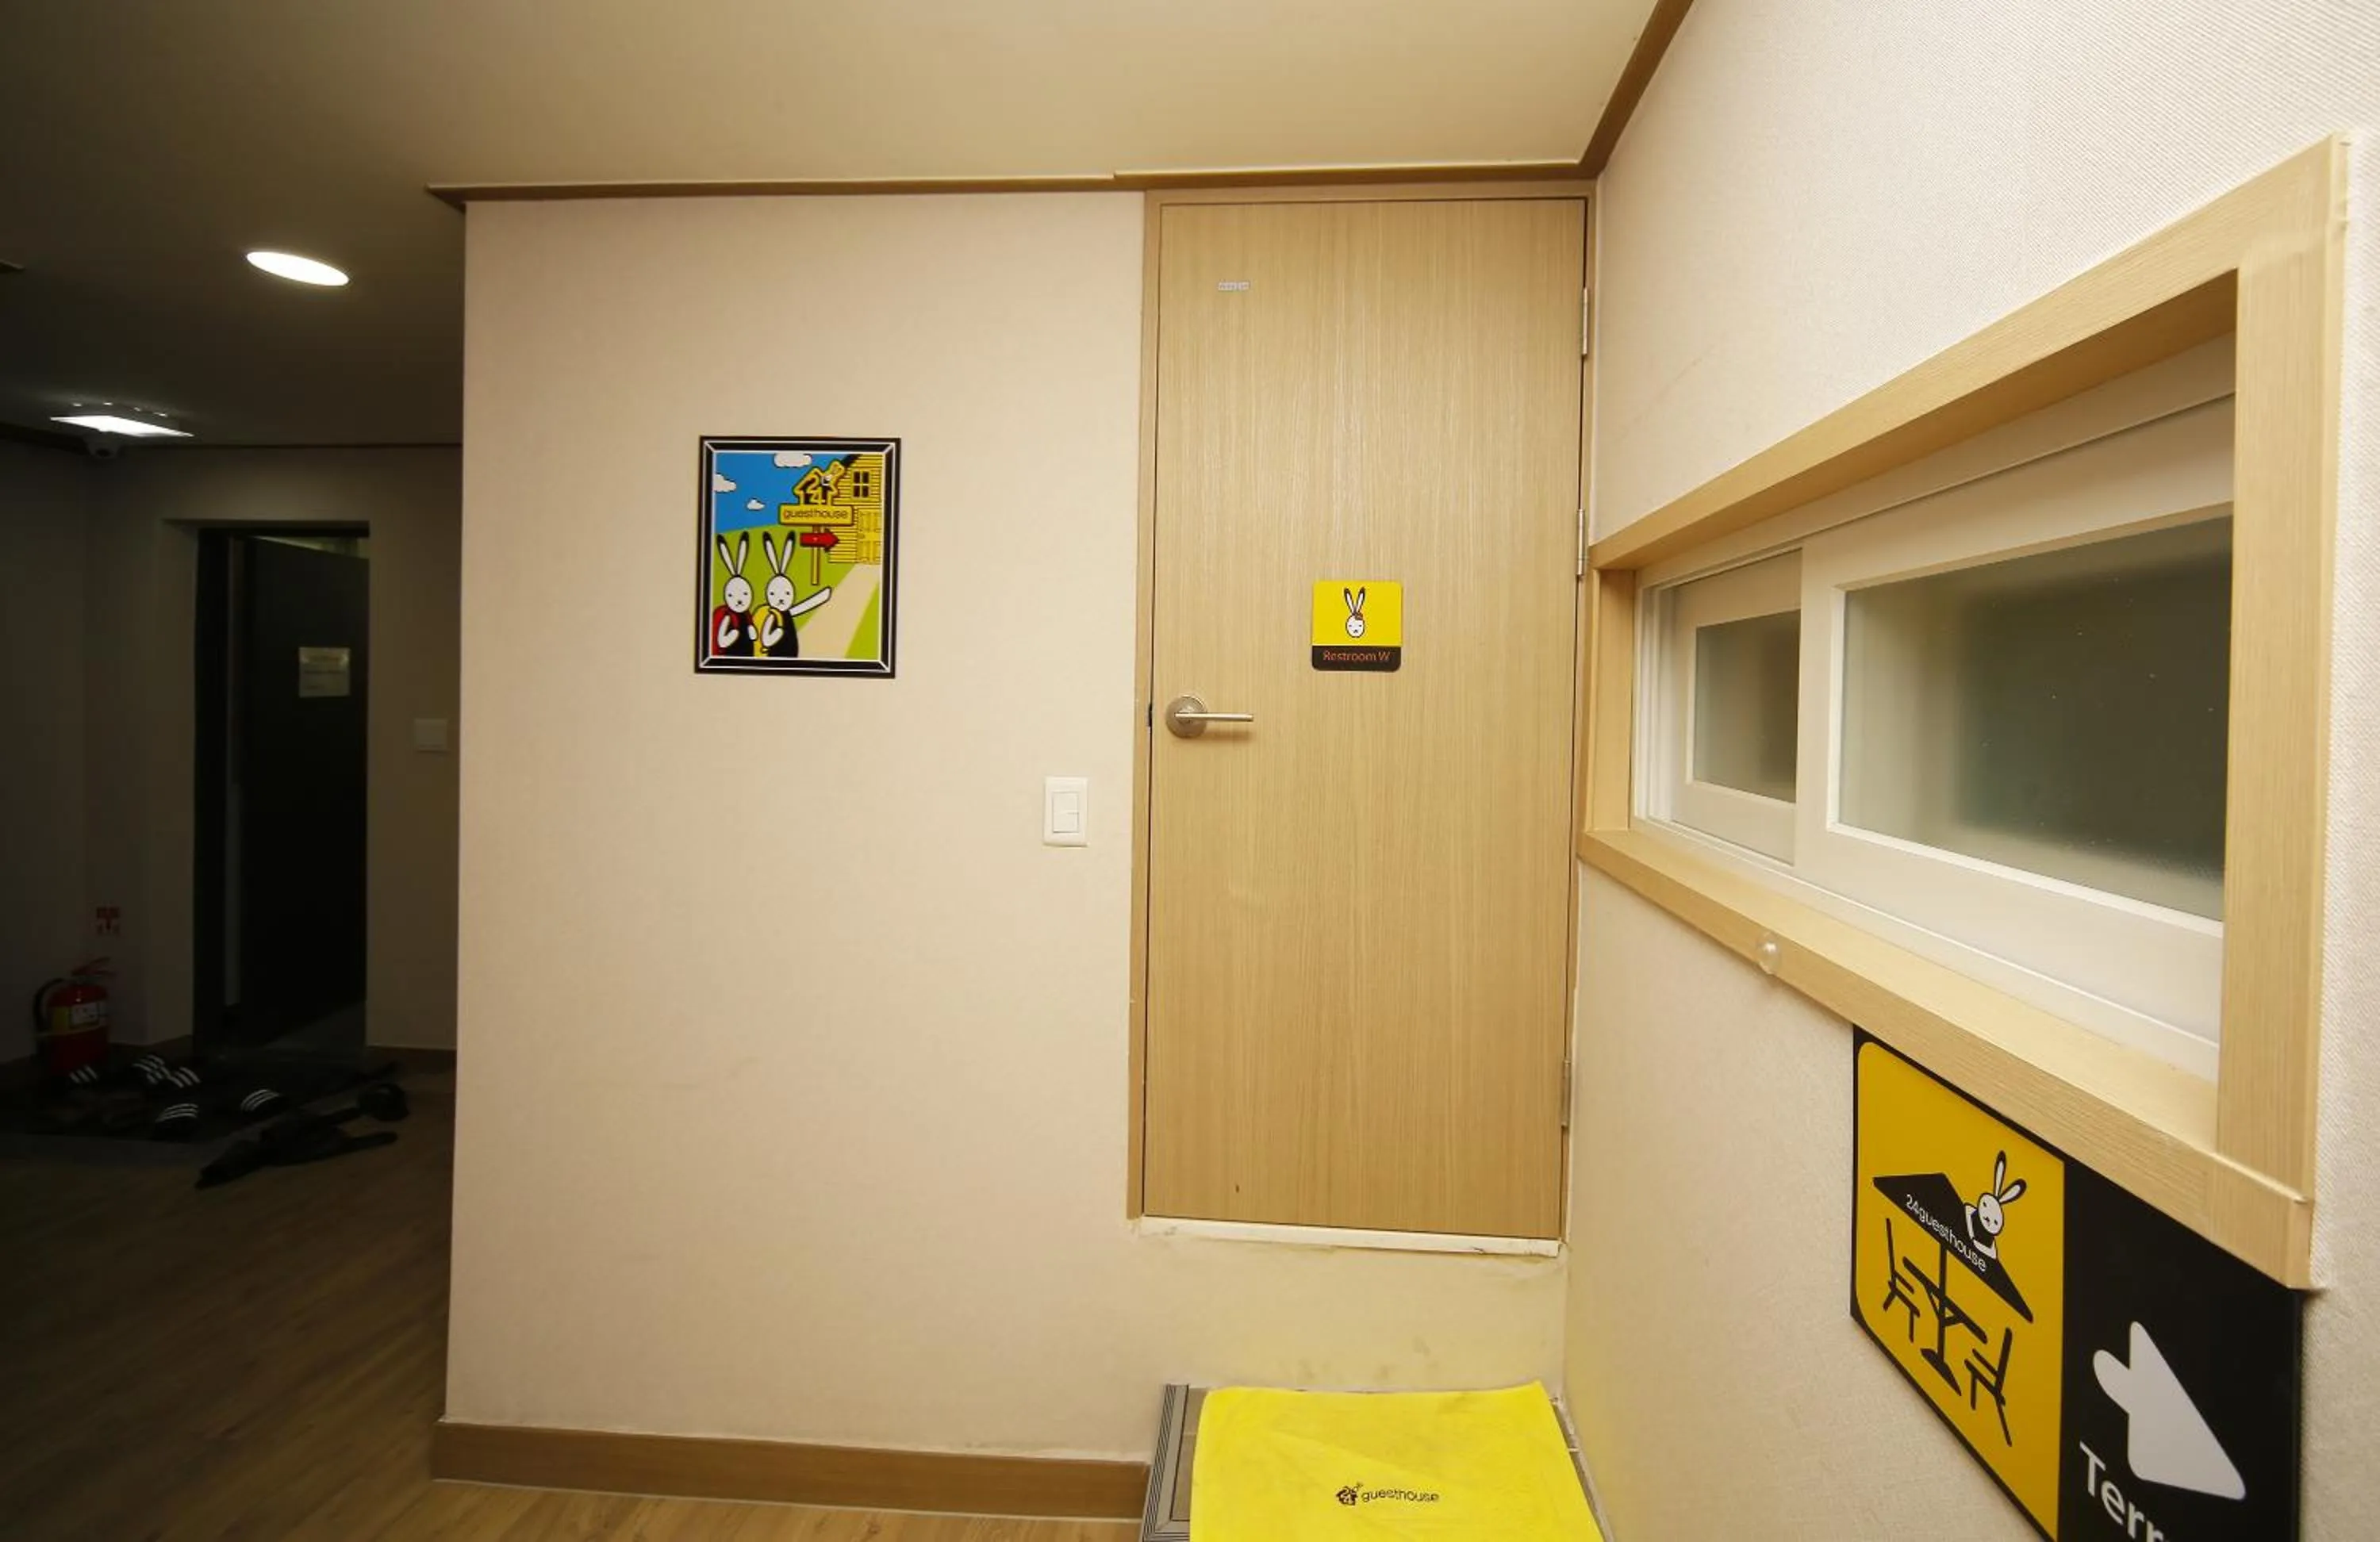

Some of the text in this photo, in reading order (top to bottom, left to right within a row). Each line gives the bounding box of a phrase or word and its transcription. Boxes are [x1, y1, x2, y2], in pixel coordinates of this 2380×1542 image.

[782, 508, 849, 520] guesthouse
[1322, 650, 1391, 661] Restroom W
[1361, 1487, 1440, 1503] guesthouse
